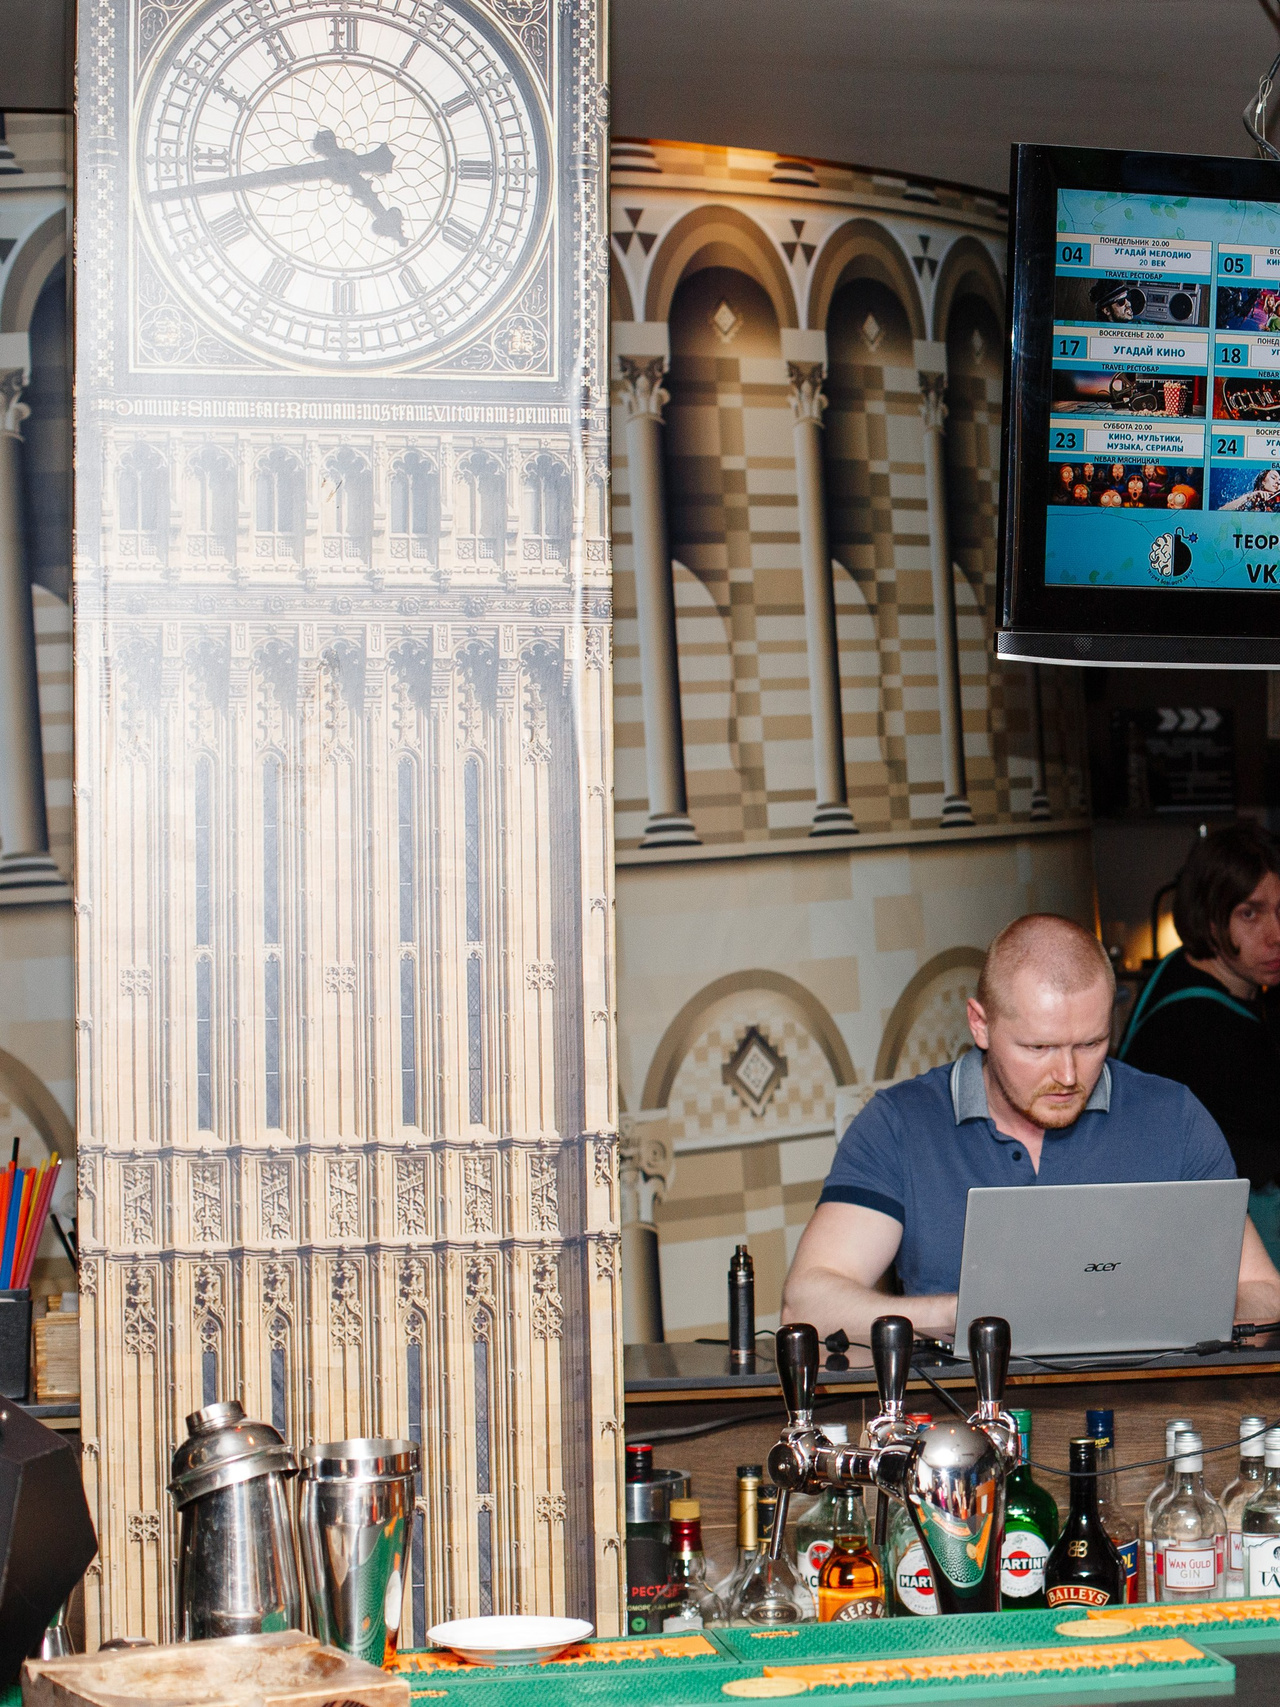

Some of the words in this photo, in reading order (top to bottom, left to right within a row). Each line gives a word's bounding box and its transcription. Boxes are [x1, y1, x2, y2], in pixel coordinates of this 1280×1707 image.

[1100, 237, 1149, 246] ПОНЕДЕЛЬНИК
[1062, 246, 1082, 262] 04
[1115, 248, 1146, 256] УГАДАЙ
[1150, 250, 1191, 259] МЕЛОДИЮ
[1224, 257, 1243, 273] 05
[1130, 272, 1163, 280] РЕСТОБАР
[1099, 330, 1144, 338] ВОСКРЕСЕНЬЕ
[1060, 340, 1080, 356] 17
[1114, 345, 1153, 356] УГАДАЙ
[1157, 348, 1185, 358] КИНО
[1222, 348, 1241, 363] 18
[1056, 433, 1076, 448] 23
[1109, 433, 1133, 441] КИНО,
[1137, 435, 1183, 443] МУЛЬТИКИ,
[1107, 443, 1144, 451] МУЗЫКА,
[1146, 444, 1183, 452] СЕРИАЛЫ
[1217, 439, 1237, 454] 24
[1084, 1262, 1121, 1272] acer
[1180, 1569, 1200, 1579] GIN
[901, 1576, 932, 1588] MART
[1049, 1587, 1106, 1604] BAILEYS
